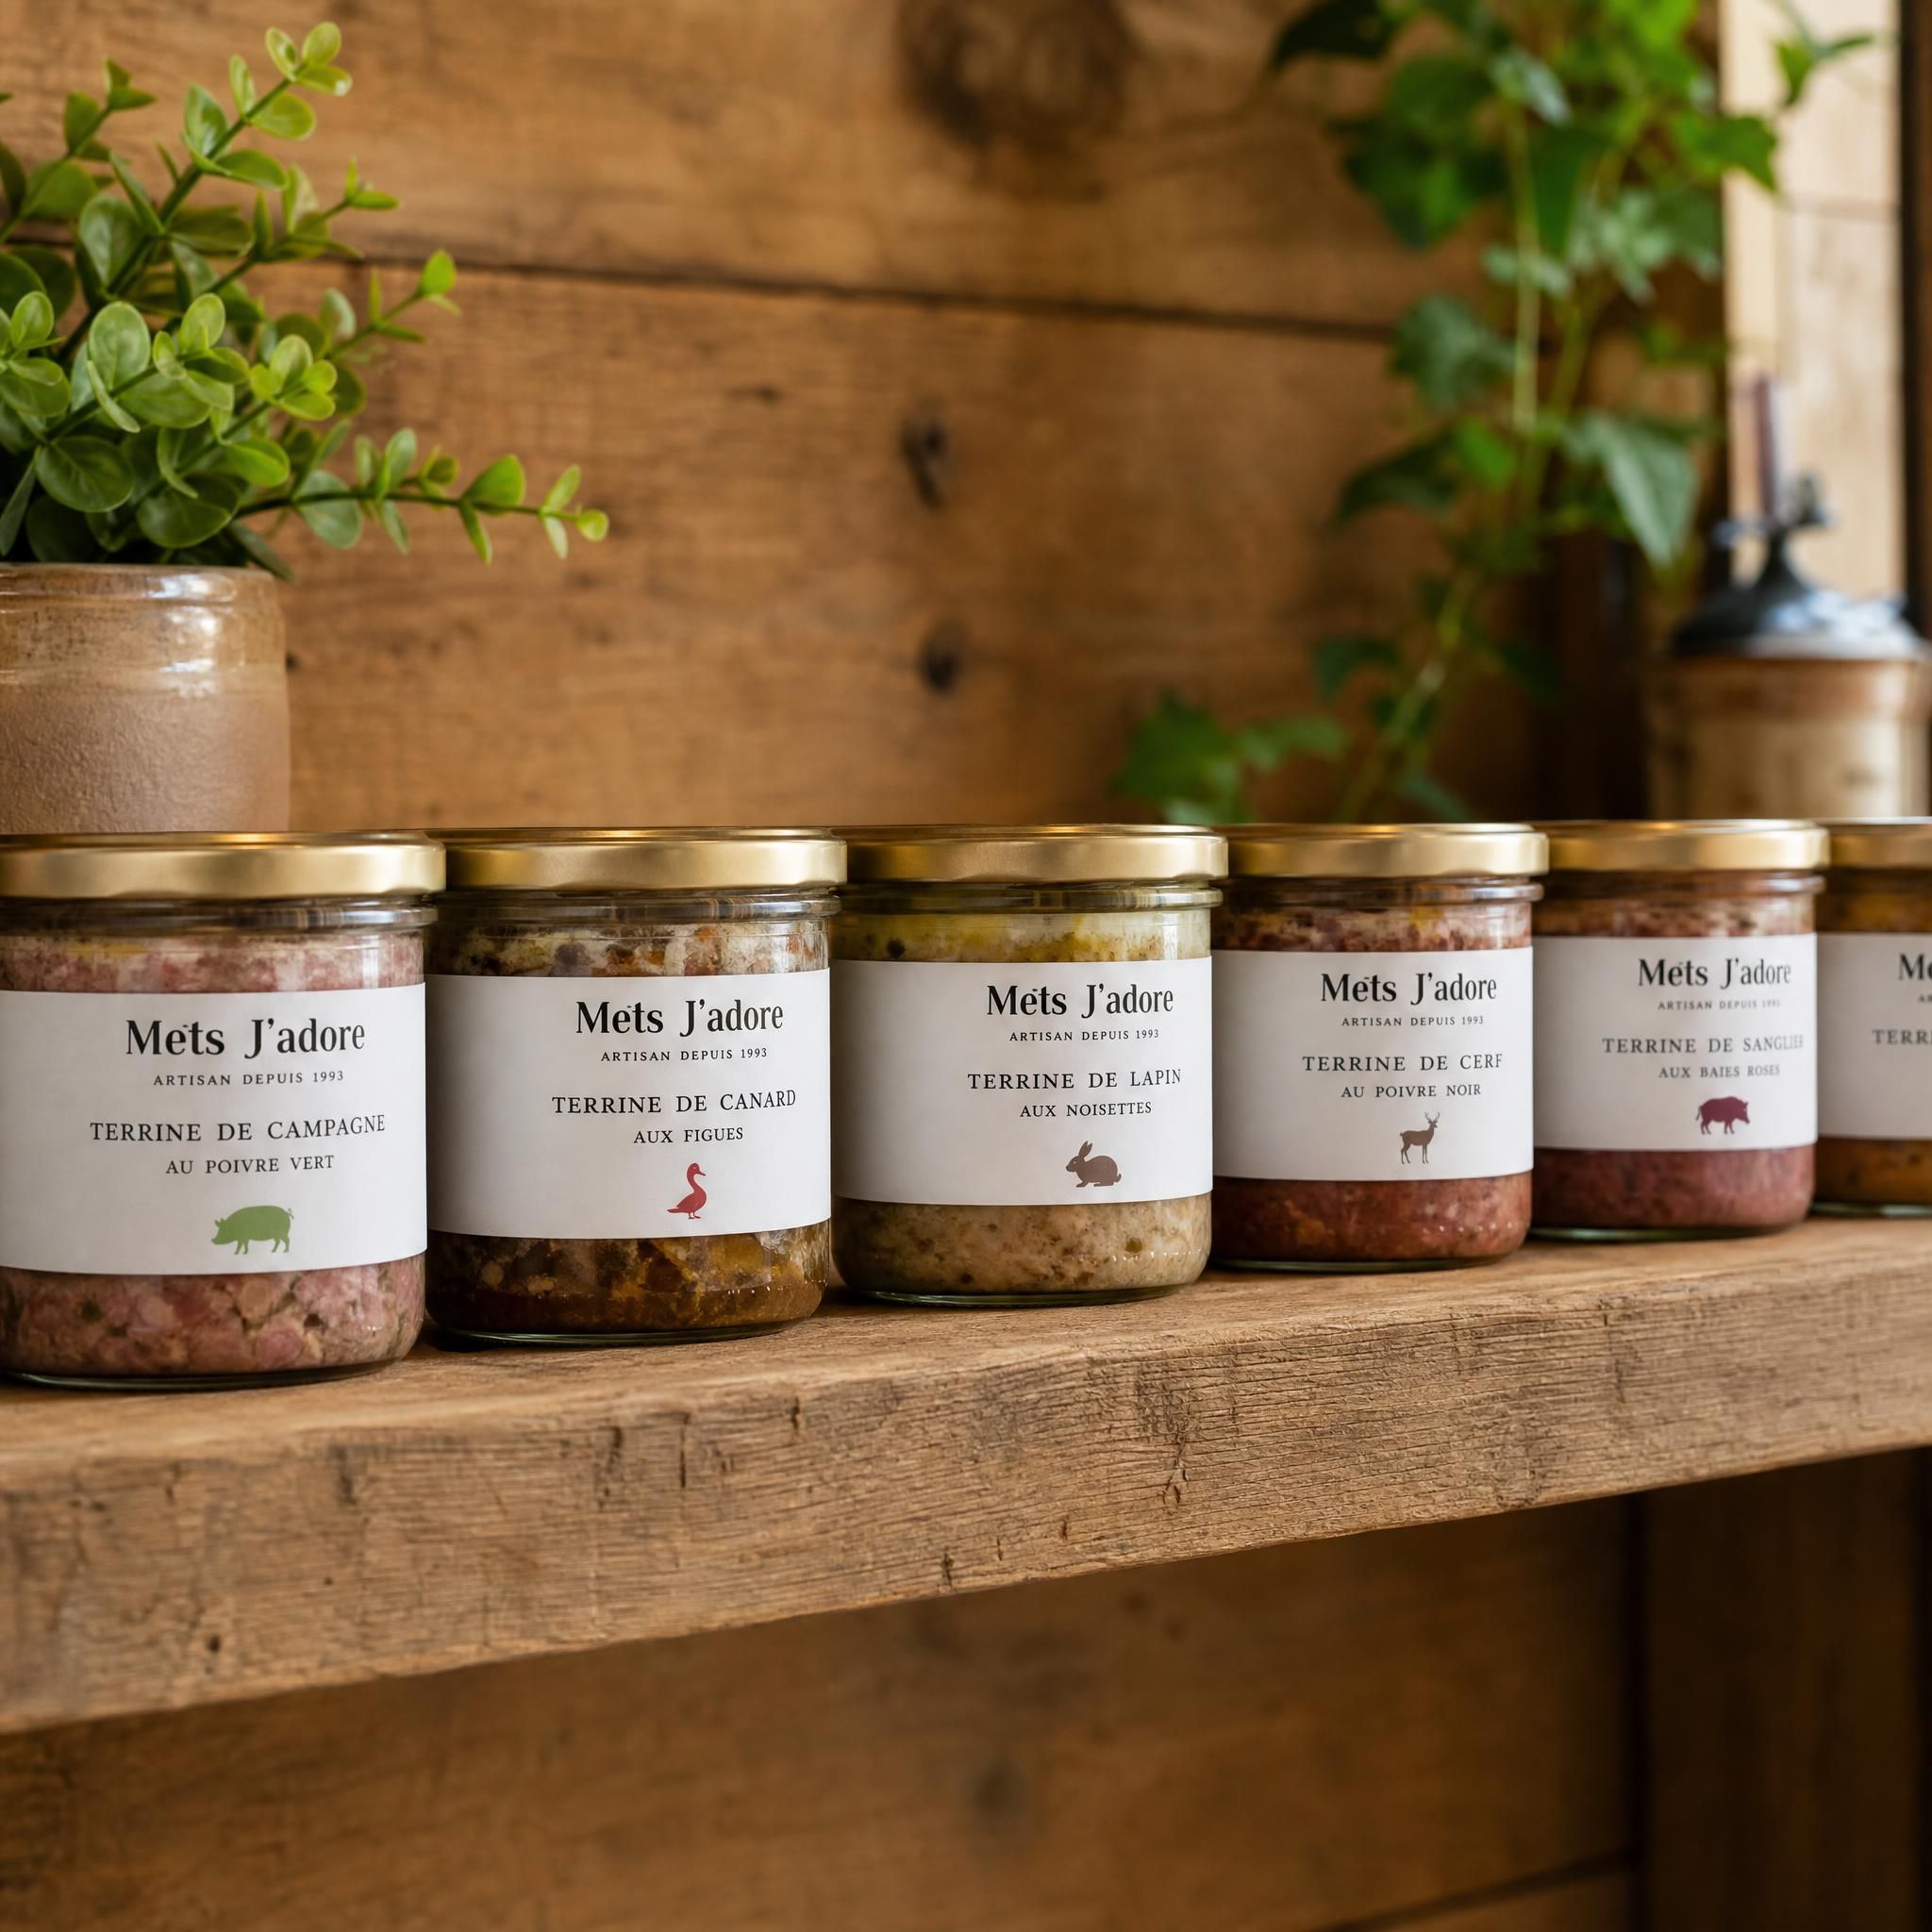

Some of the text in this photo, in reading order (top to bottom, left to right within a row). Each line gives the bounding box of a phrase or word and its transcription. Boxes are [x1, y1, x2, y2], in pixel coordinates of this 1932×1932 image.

[1721, 958, 1790, 990] J'adore
[1410, 973, 1496, 1006] J'adore
[1081, 983, 1173, 1019] J'adore
[1657, 1001, 1712, 1010] ARTISAN
[1719, 1000, 1757, 1009] DEPUIS
[679, 999, 783, 1037] J'adore
[1341, 1015, 1483, 1026] ARTISAN DEPUIS 1993
[244, 1018, 364, 1059] J'adore
[1009, 1029, 1158, 1041] ARTISAN DEPUIS 1993
[1872, 1029, 1932, 1045] TERR
[1602, 1039, 1696, 1053] TERRINE
[1708, 1038, 1732, 1053] DE
[601, 1048, 766, 1061] ARTISAN DEPUIS 1993
[1303, 1054, 1502, 1071] TERRINE DE CERF
[154, 1070, 343, 1086] ARTISAN DEPUIS 1993
[968, 1069, 1180, 1089] TERRINE DE LAPIN
[1658, 1064, 1780, 1078] AUX BAIES ROSES
[1341, 1084, 1480, 1098] AU POIVRE NOIR
[552, 1090, 795, 1113] TERRINE DE CANARD
[1020, 1102, 1151, 1117] AUX NOISETTES
[91, 1115, 385, 1141] TERRINE DE CAMPAGNE
[634, 1127, 742, 1143] AUX FIGUES
[166, 1155, 334, 1174] AU POIVRE VERT
